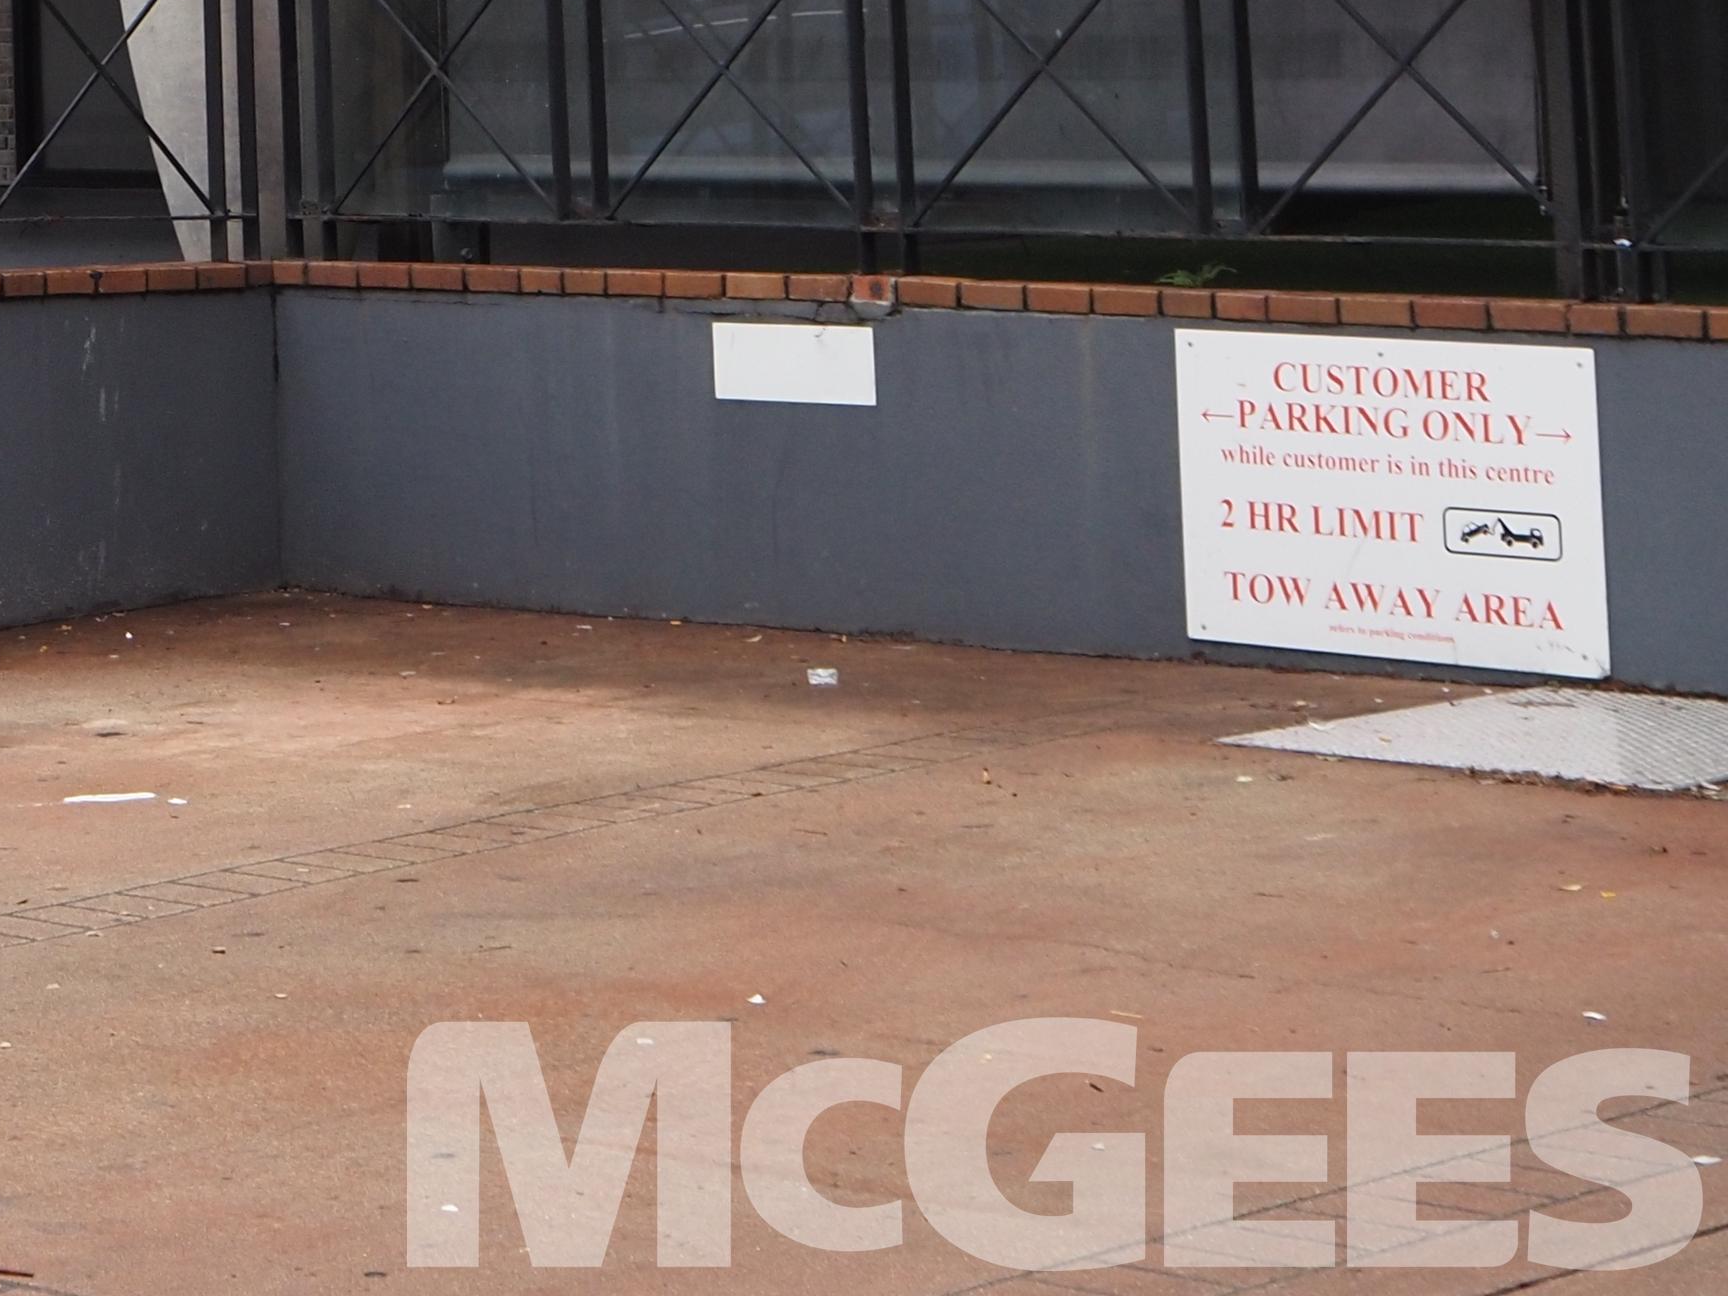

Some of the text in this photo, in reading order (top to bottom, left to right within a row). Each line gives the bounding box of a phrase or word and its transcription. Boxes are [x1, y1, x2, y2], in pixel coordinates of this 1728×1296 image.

[1272, 361, 1491, 402] CUSTOMER
[1236, 398, 1533, 445] PARKING ONLY
[1220, 444, 1556, 485] while customer is in this centre
[1220, 499, 1425, 543] 2 HR LIMIT
[1224, 570, 1565, 632] TOW AWAY AREA
